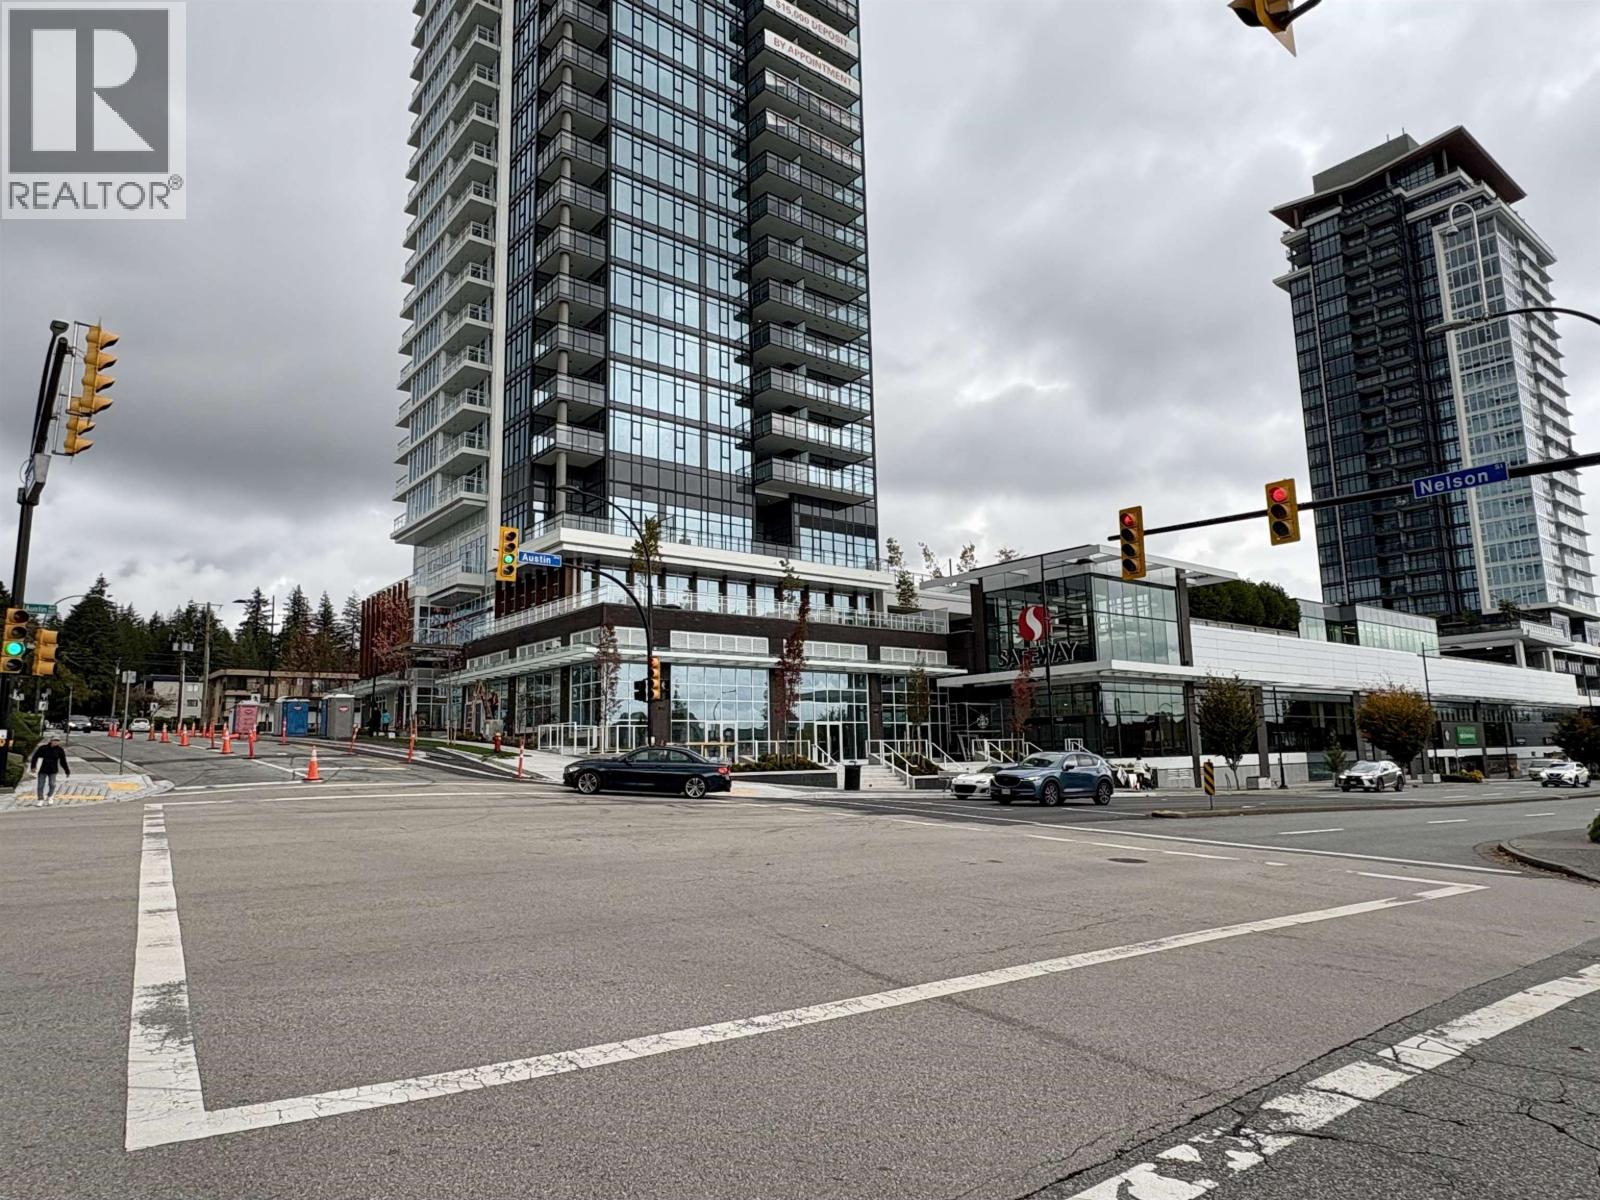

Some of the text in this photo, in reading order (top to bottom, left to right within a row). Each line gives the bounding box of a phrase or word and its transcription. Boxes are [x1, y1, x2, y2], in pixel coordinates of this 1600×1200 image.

[811, 20, 848, 48] DEPOSIT
[773, 37, 852, 86] BY APPOINTMENT
[1420, 471, 1489, 494] Nelson
[522, 553, 552, 564] Austin
